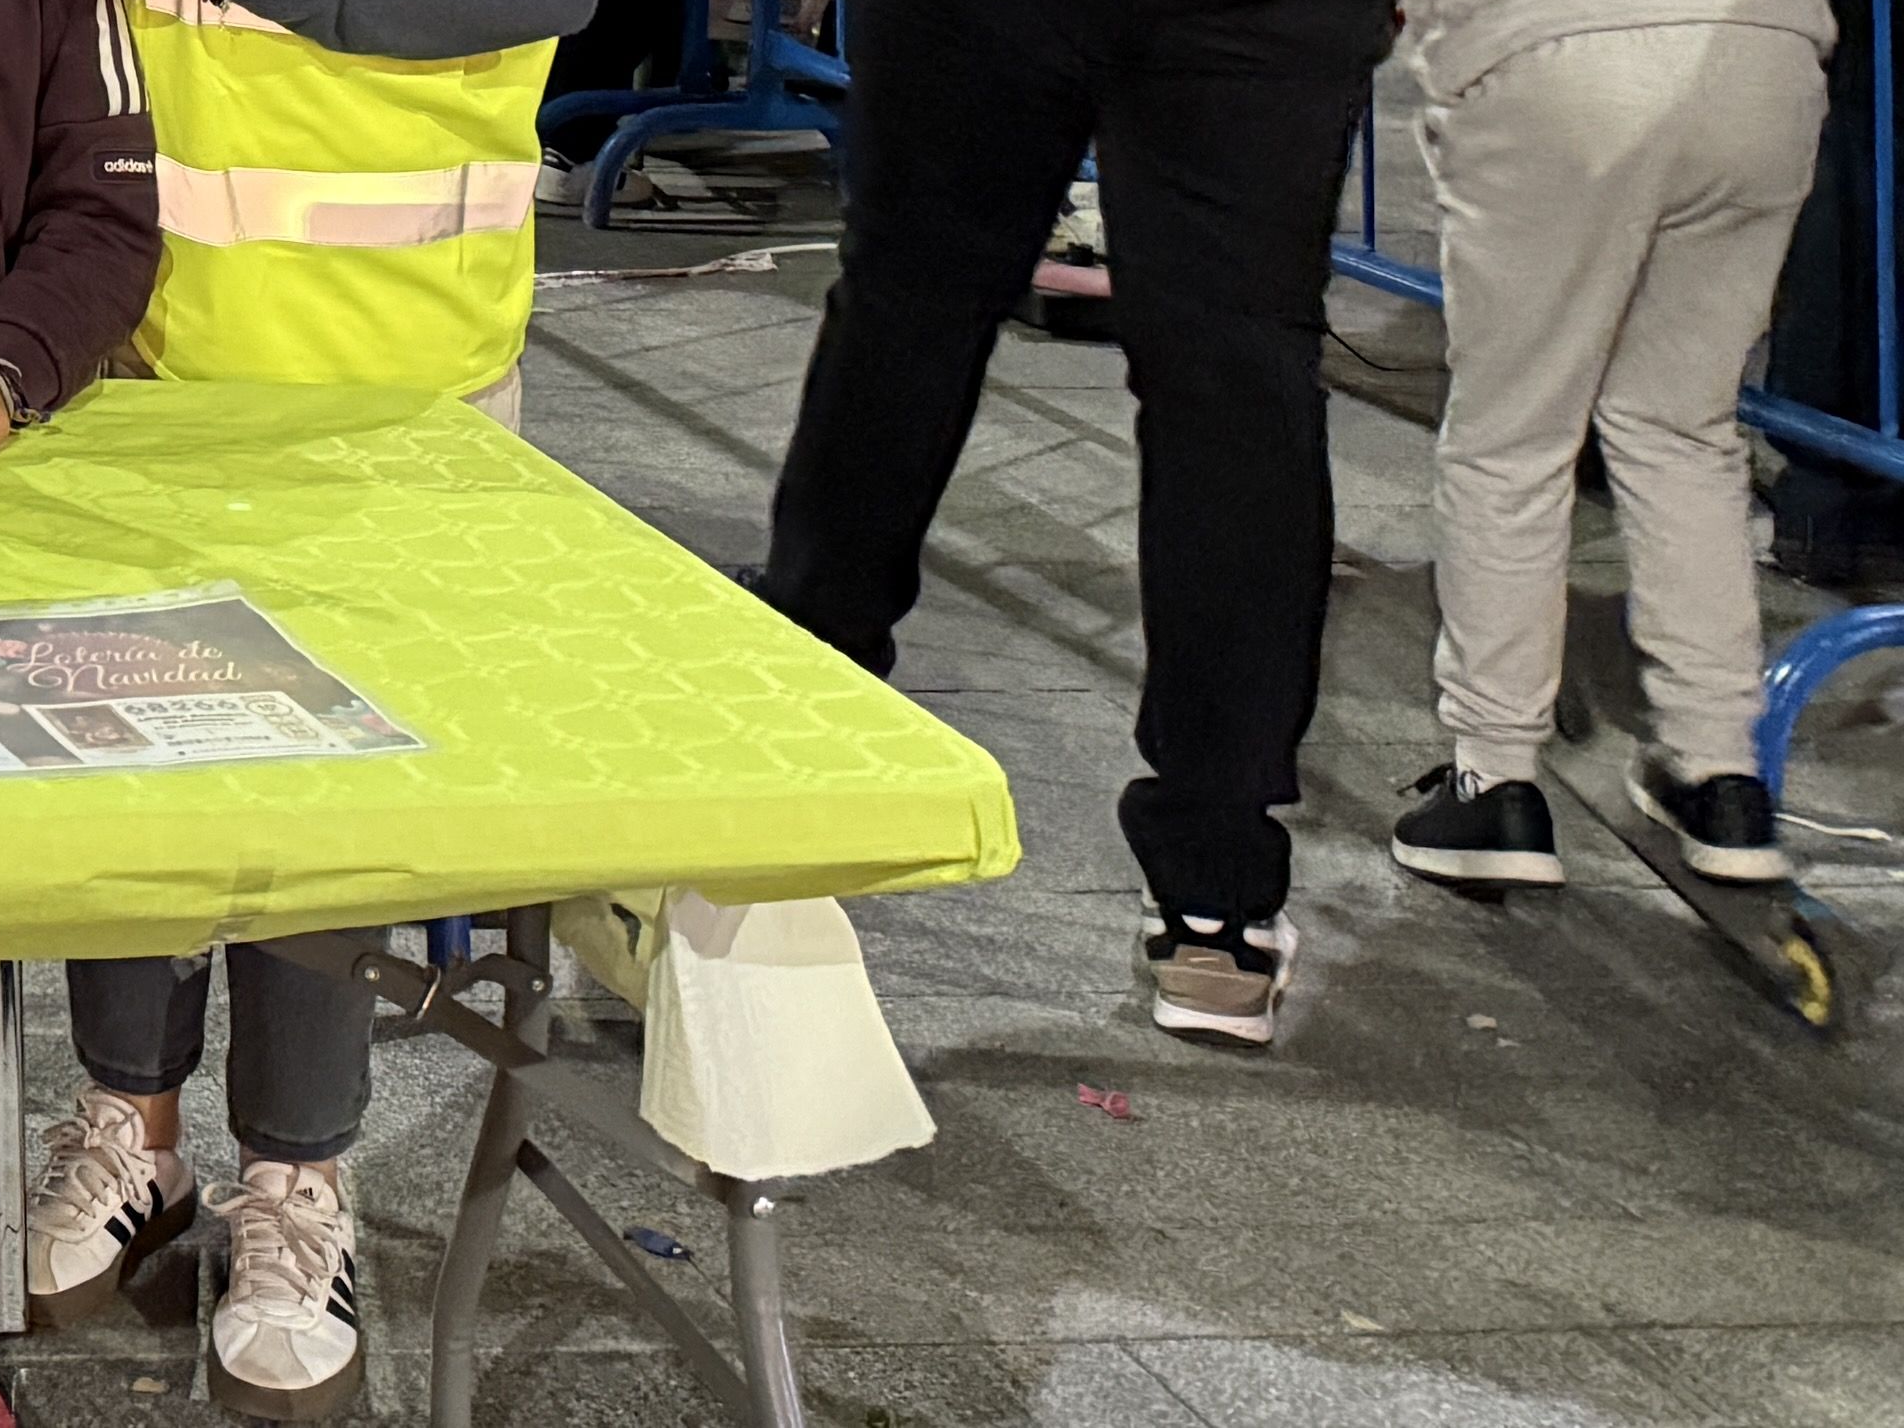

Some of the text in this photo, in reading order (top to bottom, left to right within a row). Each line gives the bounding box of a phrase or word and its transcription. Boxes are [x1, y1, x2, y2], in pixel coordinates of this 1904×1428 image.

[104, 157, 147, 175] adidas
[6, 639, 223, 673] Lotería de
[28, 661, 242, 693] Navidad
